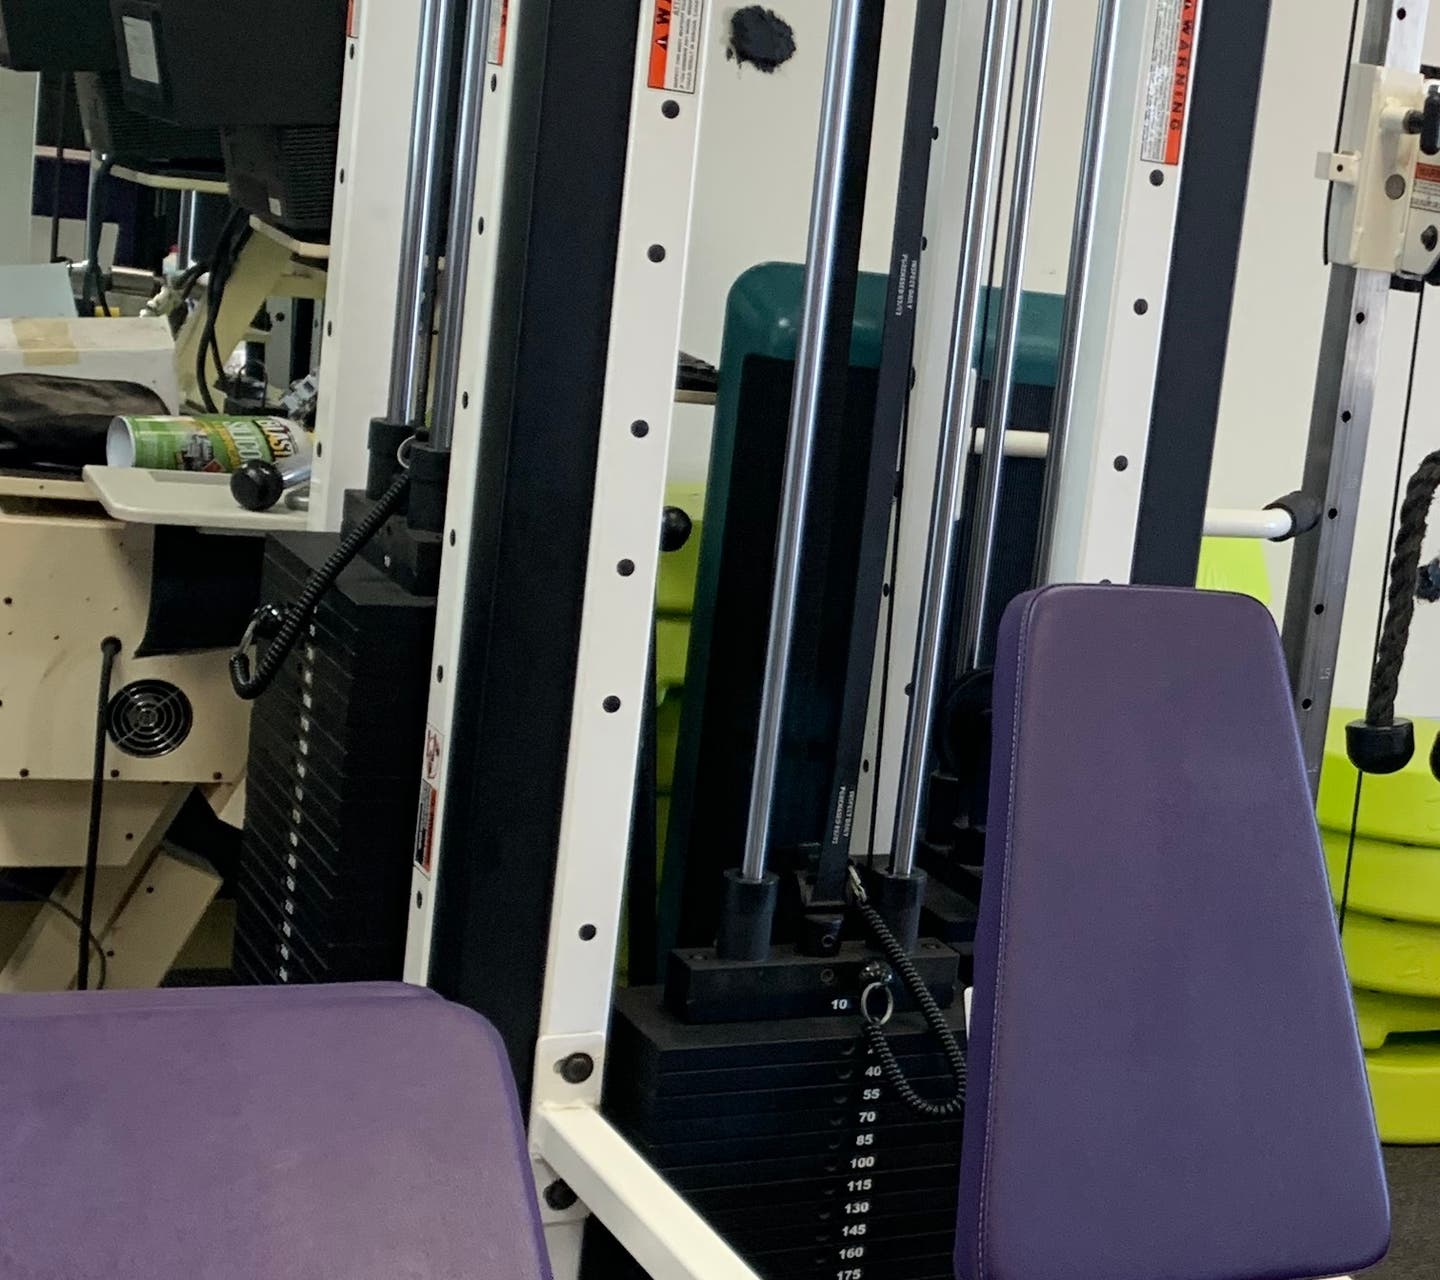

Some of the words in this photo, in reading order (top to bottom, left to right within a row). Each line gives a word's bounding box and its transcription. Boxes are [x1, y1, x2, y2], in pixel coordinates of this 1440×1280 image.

[1170, 22, 1193, 130] WARNING
[831, 998, 848, 1010] 10
[865, 1066, 881, 1077] 40
[863, 1088, 880, 1100] 55
[859, 1111, 876, 1123] 70
[856, 1134, 873, 1146] 85
[850, 1156, 875, 1169] 100
[847, 1179, 872, 1191] 115
[845, 1202, 870, 1214] 130
[842, 1224, 866, 1236] 145
[839, 1247, 864, 1259] 160
[837, 1269, 861, 1280] 175
